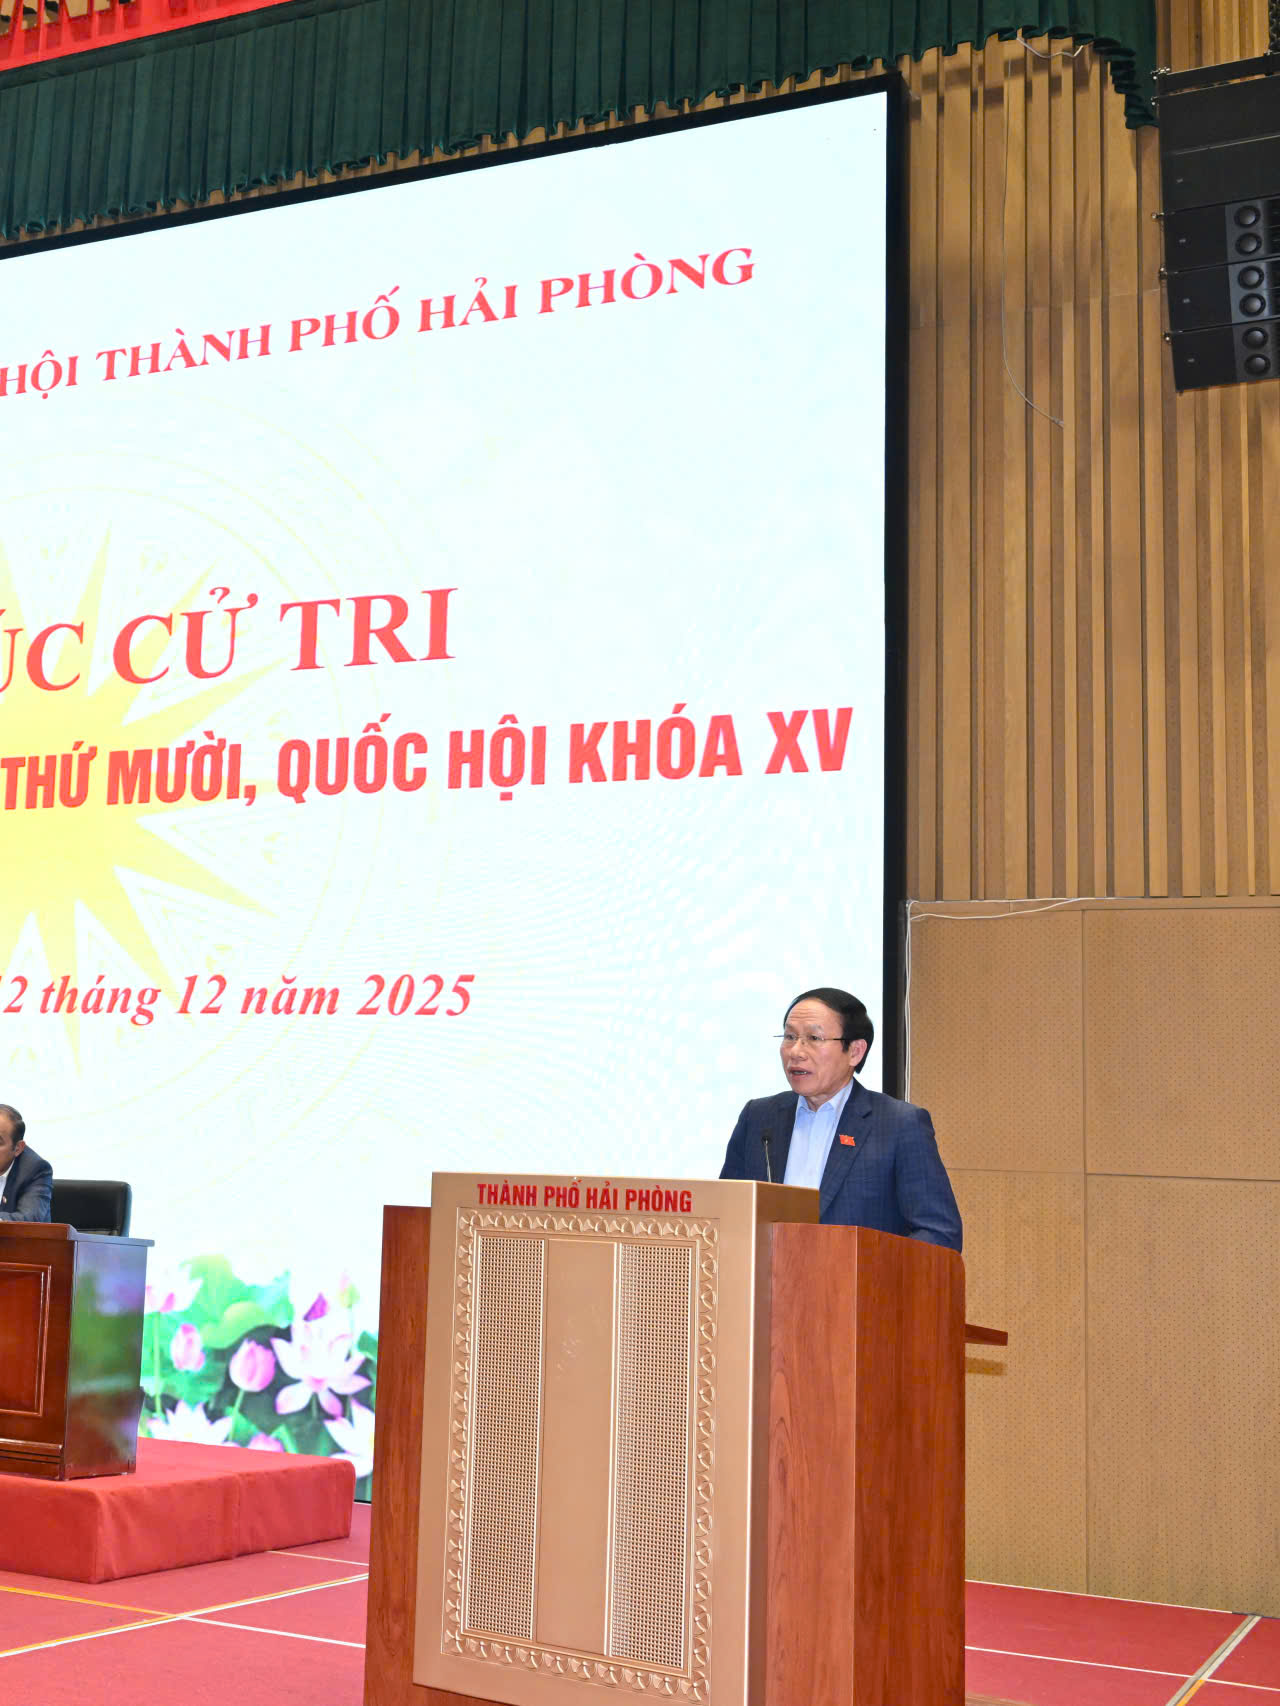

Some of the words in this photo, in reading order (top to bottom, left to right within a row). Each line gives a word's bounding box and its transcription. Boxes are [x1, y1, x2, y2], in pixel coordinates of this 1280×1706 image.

[95, 325, 272, 381] THÀNH
[289, 286, 400, 353] PHỐ
[418, 276, 519, 333] HẢI
[538, 247, 755, 314] PHÒNG
[112, 586, 259, 685] CỬ
[279, 587, 457, 671] TRI
[0, 740, 98, 811] THỨ
[106, 730, 257, 807] MƯỜI,
[276, 712, 428, 805] QUỐC
[447, 713, 547, 802] HỘI
[568, 702, 743, 784] KHÓA
[764, 706, 854, 775] XV
[39, 975, 162, 1027] tháng
[177, 974, 228, 1015] 12
[240, 975, 340, 1016] năm
[356, 973, 477, 1017] 2025
[477, 1180, 537, 1207] THÀNH
[544, 1178, 583, 1209] PHỐ
[586, 1181, 619, 1211] HẢI
[625, 1184, 693, 1213] PHÒNG
